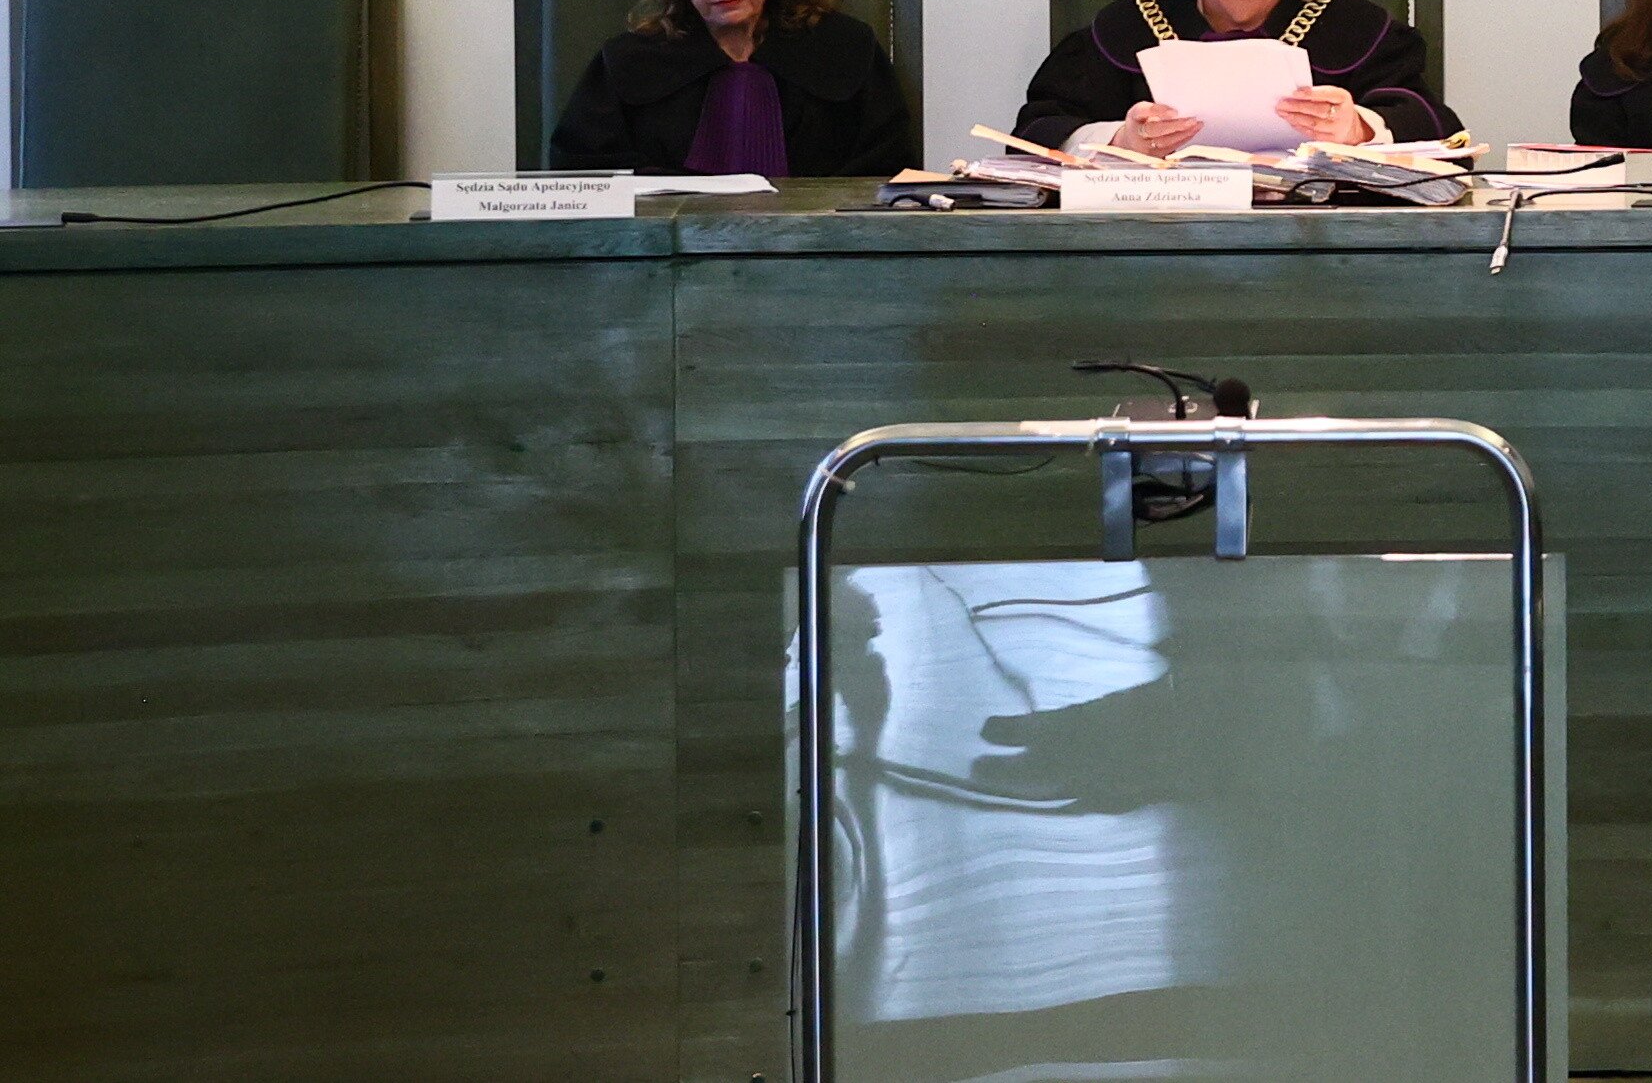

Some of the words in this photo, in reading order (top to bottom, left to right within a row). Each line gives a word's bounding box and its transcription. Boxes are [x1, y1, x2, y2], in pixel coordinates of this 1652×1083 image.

[456, 182, 495, 194] Sędzia
[498, 182, 528, 195] Sądu
[531, 180, 611, 195] Apelacyjnego
[1112, 192, 1142, 202] Anna
[550, 200, 588, 211] Janicz
